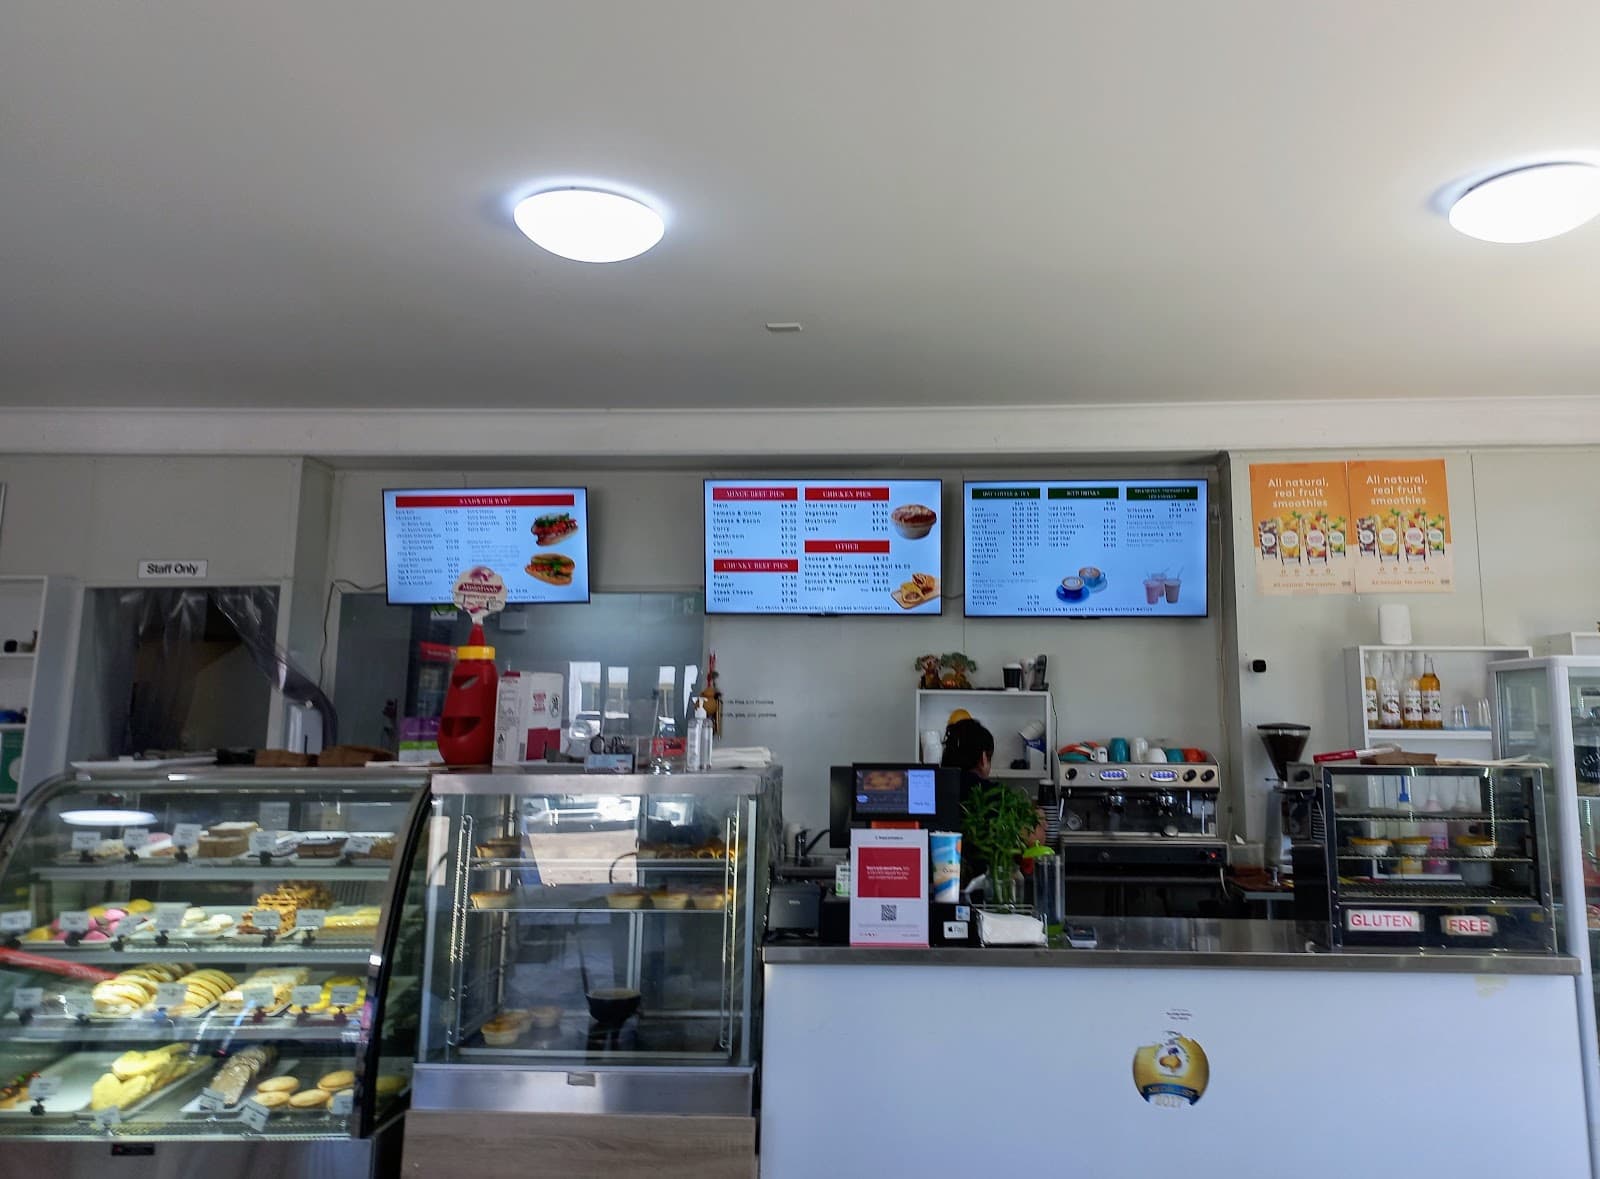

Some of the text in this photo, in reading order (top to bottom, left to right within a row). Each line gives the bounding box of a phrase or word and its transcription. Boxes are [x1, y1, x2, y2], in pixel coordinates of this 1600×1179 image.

[1267, 478, 1330, 489] All natural,
[1366, 475, 1428, 486] All natural,
[822, 490, 873, 498] CHICKEN PIES
[1275, 489, 1325, 497] real fruit
[1373, 487, 1424, 495] real fruit
[1272, 499, 1329, 508] smoothies
[1370, 497, 1427, 505] smoothies
[146, 562, 199, 576] Staff Only
[1351, 914, 1413, 927] GLUTEN
[1449, 919, 1490, 932] FREE
